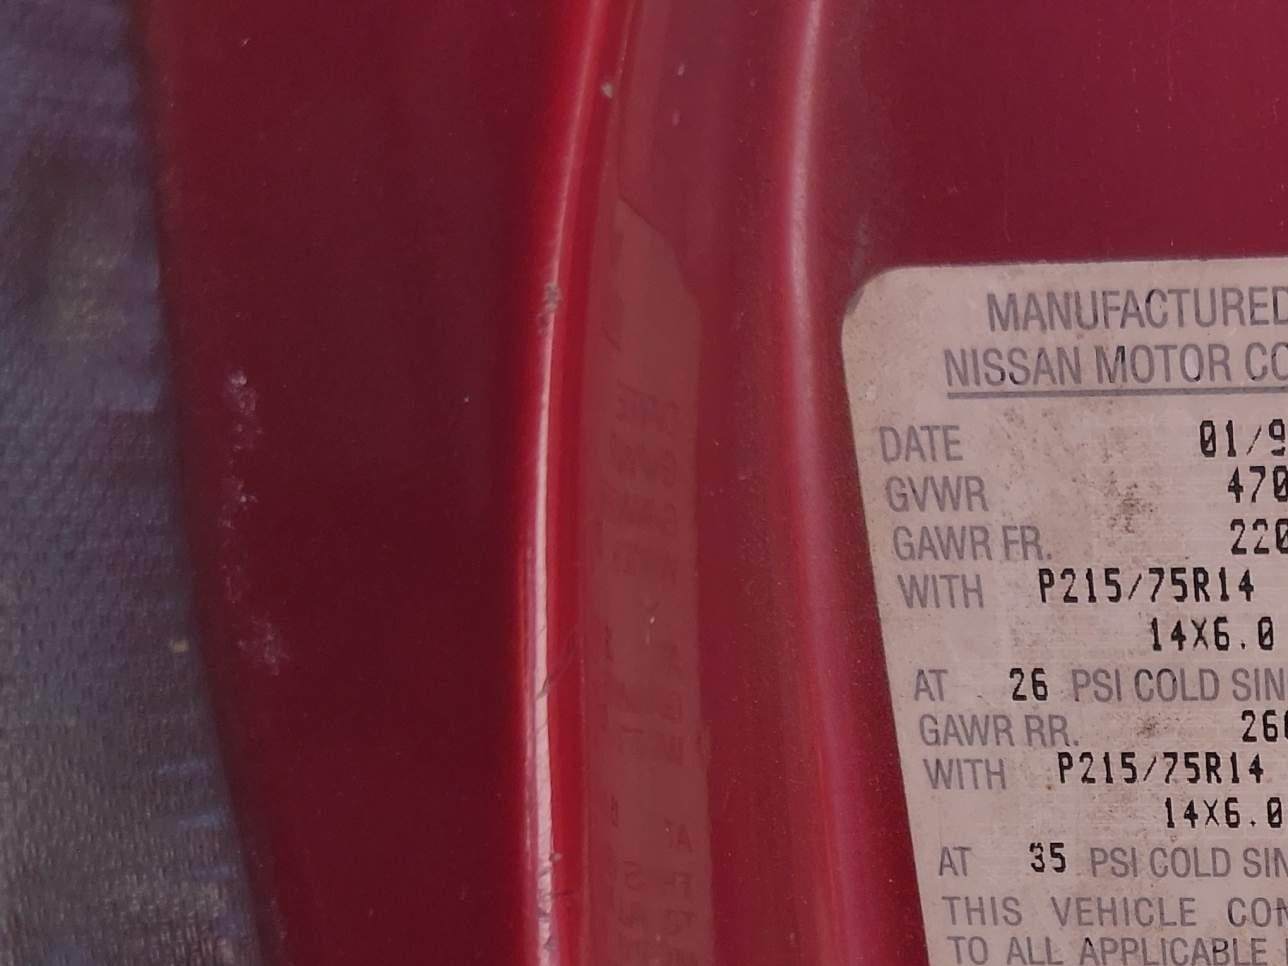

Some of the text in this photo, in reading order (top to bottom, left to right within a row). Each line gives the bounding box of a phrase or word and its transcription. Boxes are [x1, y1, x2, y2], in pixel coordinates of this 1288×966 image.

[943, 344, 1083, 389] NISSAN
[1094, 343, 1230, 385] MOTOR
[879, 424, 963, 463] DATE
[884, 476, 988, 514] GVWR
[892, 525, 991, 562] GAWR
[1002, 525, 1053, 562] FR.
[898, 573, 984, 610] WITH
[1038, 568, 1256, 604] P215/75R14
[1149, 617, 1275, 652] 14X6.0
[914, 669, 948, 702] AT
[1008, 669, 1049, 701] 26
[1071, 671, 1122, 702] PSI
[1134, 669, 1220, 702] COLD
[919, 714, 1014, 748] GAWR
[1024, 714, 1080, 748] RR.
[925, 759, 1008, 791] WITH
[1059, 752, 1264, 785] P215/75R14
[1164, 798, 1282, 829] 14X6.0
[938, 848, 972, 878] AT
[1029, 842, 1068, 872] 35
[1090, 848, 1138, 878] PSI
[1149, 846, 1232, 878] COLD
[942, 896, 1023, 927] THIS
[1051, 896, 1197, 928] VEHICLE
[950, 936, 990, 966] TO
[1006, 936, 1064, 966] ALL
